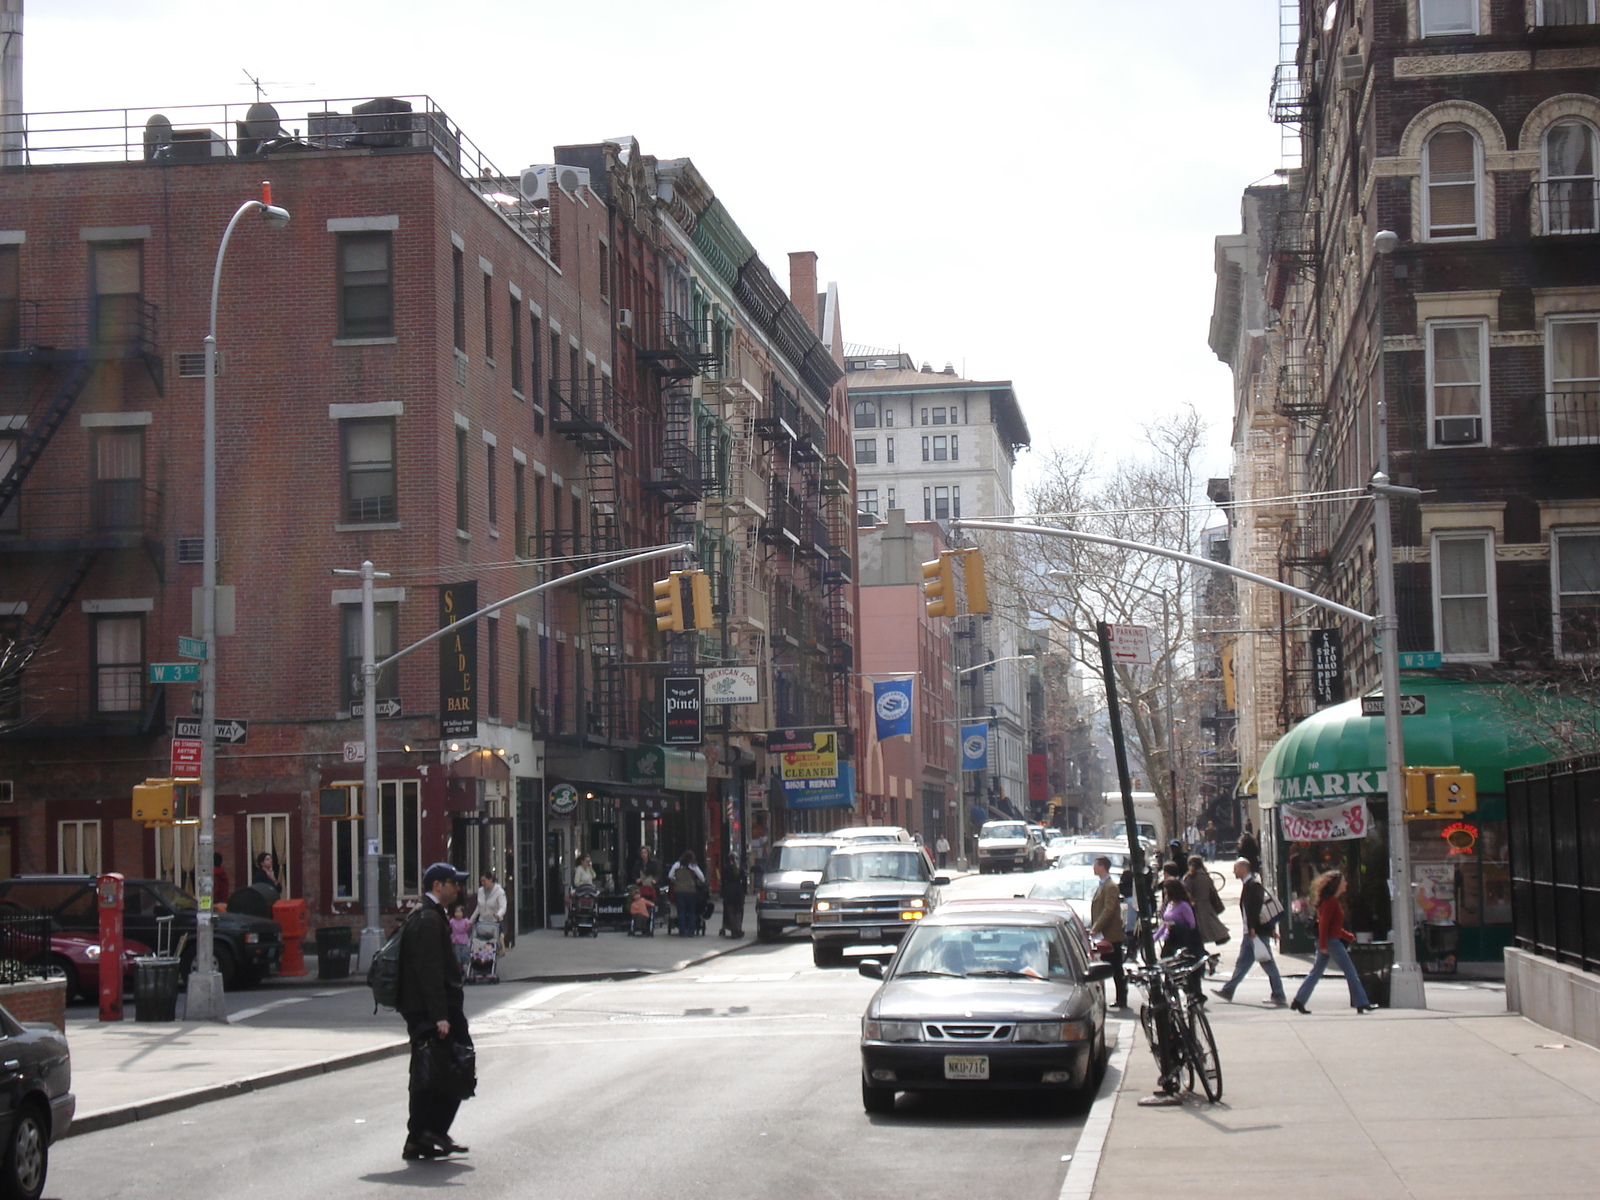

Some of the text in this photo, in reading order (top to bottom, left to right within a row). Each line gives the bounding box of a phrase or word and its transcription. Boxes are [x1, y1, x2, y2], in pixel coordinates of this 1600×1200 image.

[1116, 628, 1143, 637] PARKING
[1404, 655, 1413, 667] W
[1417, 654, 1425, 666] 3
[154, 666, 194, 681] W 3 ST
[1316, 647, 1324, 694] SIMPLY
[740, 672, 755, 687] FOOD
[447, 697, 470, 711] BAR
[218, 727, 239, 736] WAY
[785, 768, 834, 777] CLEANER
[785, 780, 836, 789] SHOE REPAIR
[1284, 816, 1333, 839] ROSES
